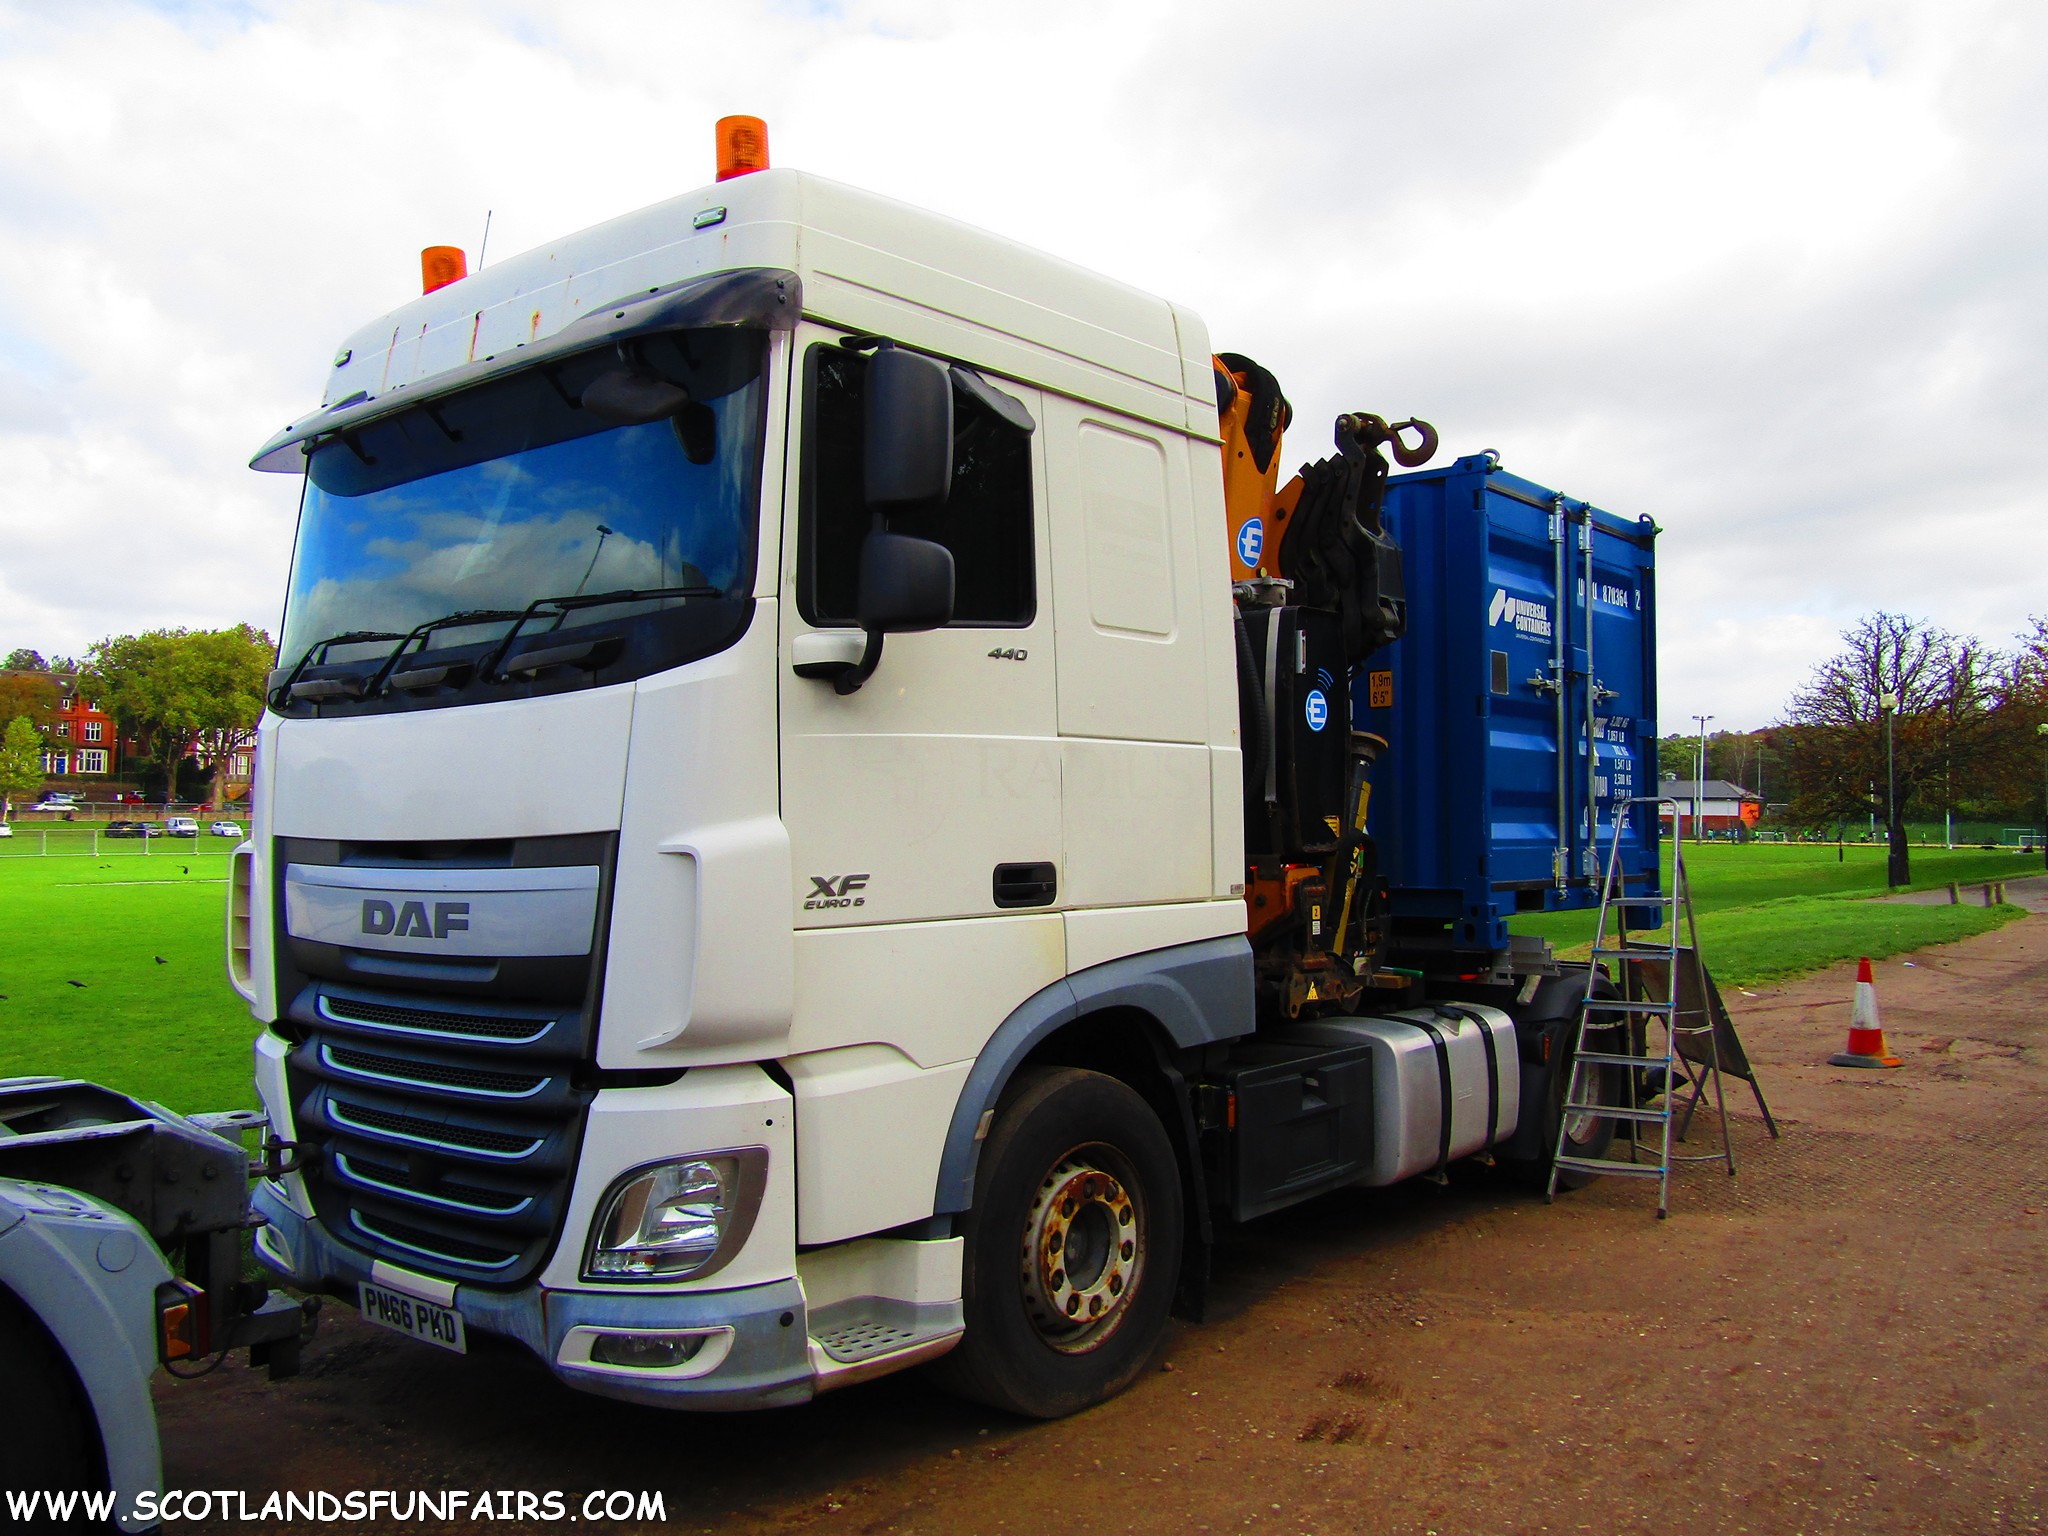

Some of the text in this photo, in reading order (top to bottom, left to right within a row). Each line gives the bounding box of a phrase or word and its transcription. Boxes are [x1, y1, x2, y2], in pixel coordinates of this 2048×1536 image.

[1516, 599, 1548, 620] UNIVERSAL
[1603, 585, 1628, 608] 870364
[1635, 589, 1641, 611] 2
[1515, 615, 1551, 637] CONTAINERS
[987, 647, 1028, 661] 440
[806, 873, 870, 899] XF
[803, 897, 865, 910] EURO 6
[362, 899, 470, 938] DAF
[365, 1287, 456, 1344] PN66 PKD
